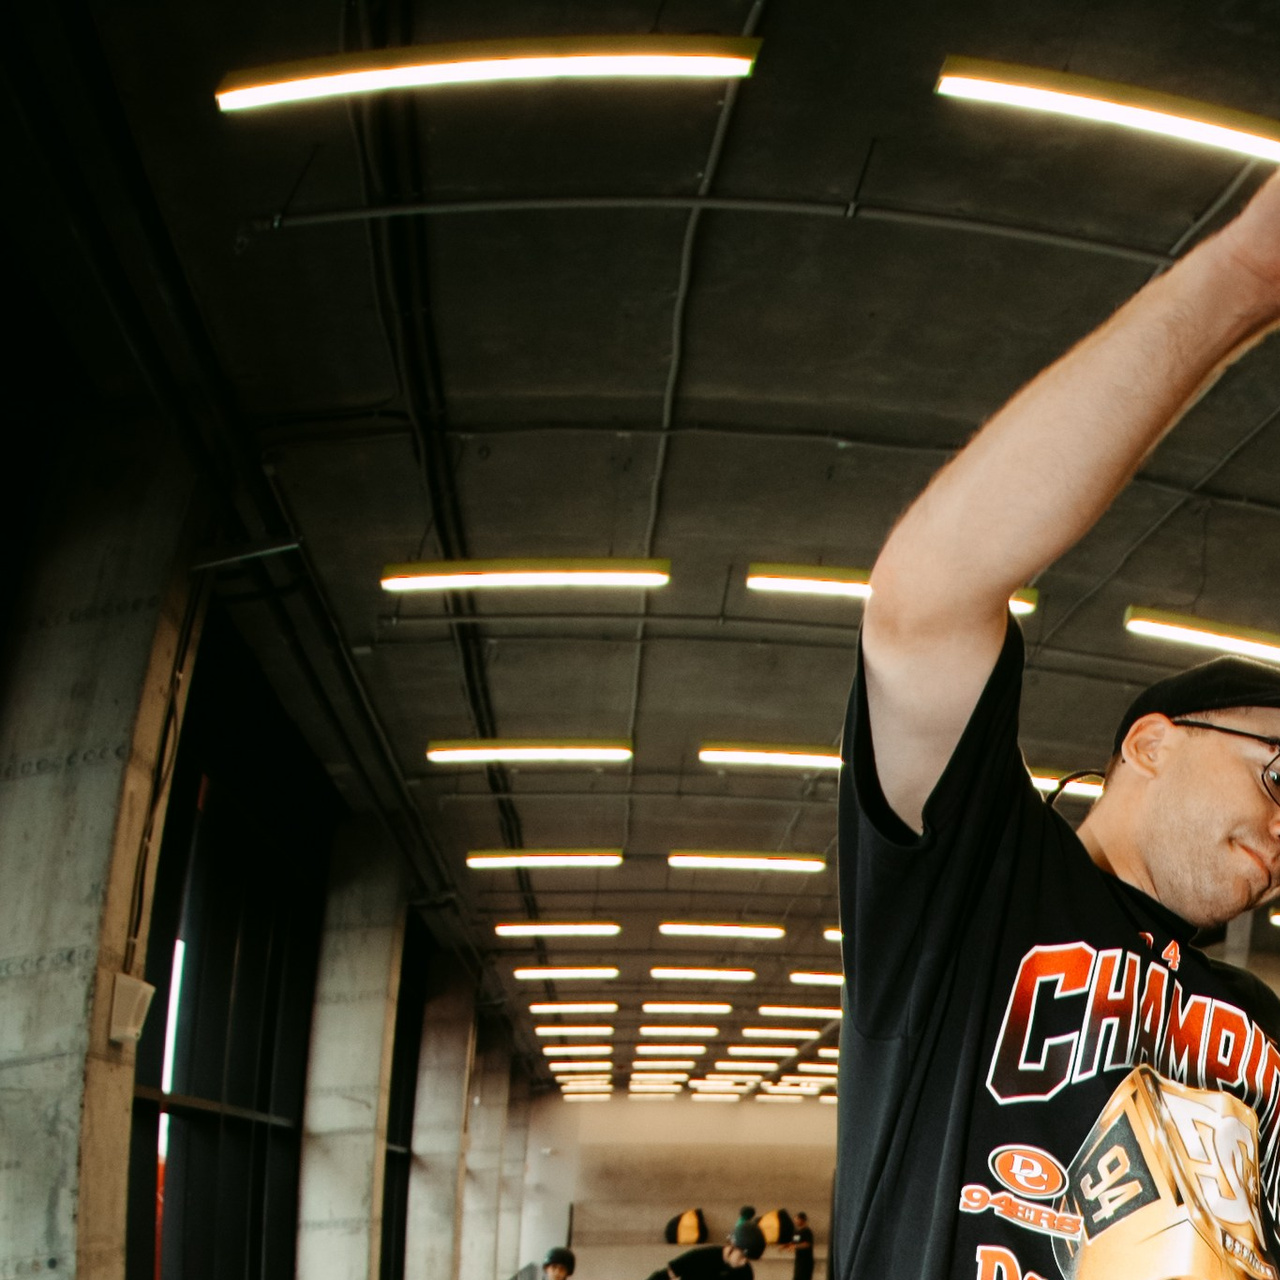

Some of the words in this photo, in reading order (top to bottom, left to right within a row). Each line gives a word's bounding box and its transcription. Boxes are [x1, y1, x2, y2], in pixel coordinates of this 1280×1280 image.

[1009, 1153, 1048, 1190] DC
[1080, 1144, 1142, 1223] 94
[959, 1184, 1084, 1240] 94ERS
